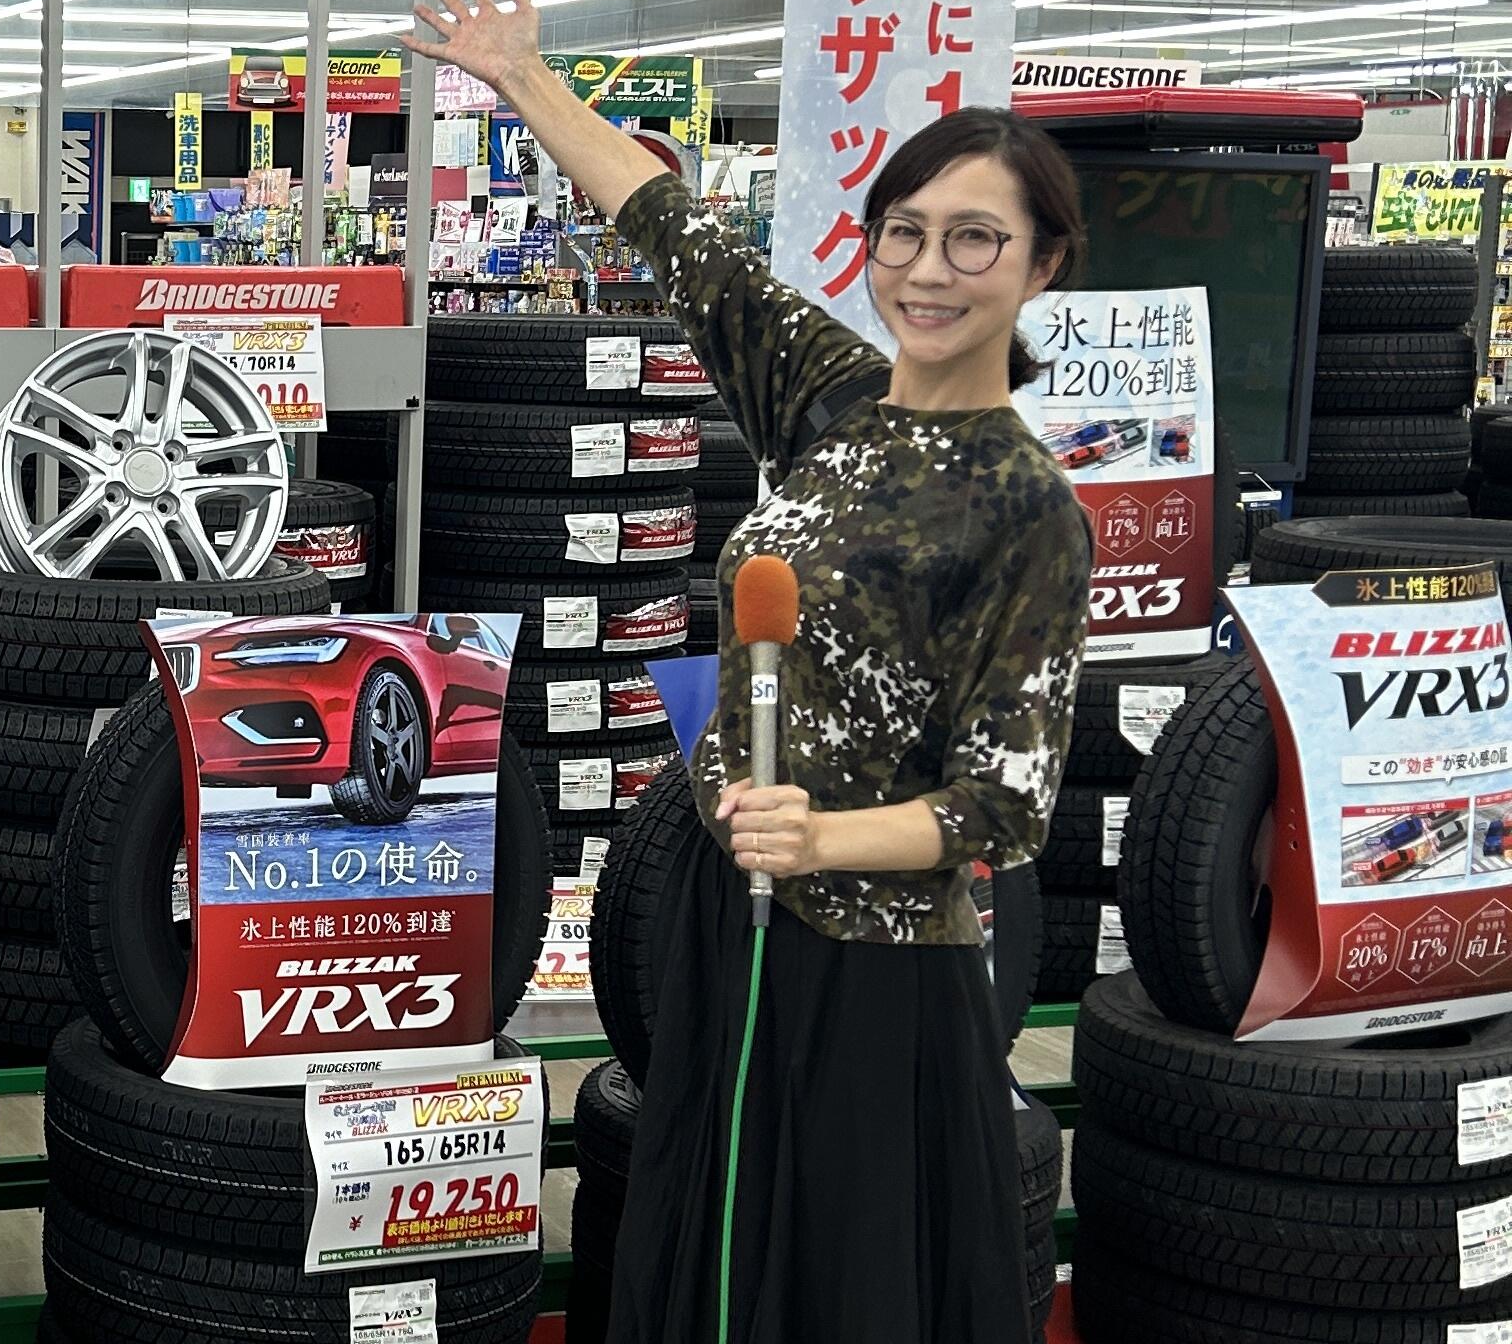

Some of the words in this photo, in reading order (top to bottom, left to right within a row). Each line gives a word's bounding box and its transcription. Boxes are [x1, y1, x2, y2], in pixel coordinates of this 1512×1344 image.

[328, 59, 381, 75] elcome
[1011, 60, 1187, 89] BRIDGESTONE
[178, 114, 199, 185] 洗車用品
[135, 279, 340, 311] BRIDGESTONE
[1043, 304, 1194, 352] 氷上性能
[233, 332, 308, 352] VRX3
[223, 355, 296, 372] 5/70R14
[1041, 355, 1197, 397] 120%到達
[1105, 517, 1139, 538] 17%
[1155, 516, 1189, 539] 向上
[1331, 621, 1506, 659] BLIZZAK
[1331, 652, 1510, 732] VRX3
[236, 832, 310, 848] 雪国装着率
[224, 840, 478, 893] No.1の使命。
[240, 909, 452, 942] 氷上性能120%到達
[1346, 944, 1388, 969] 20%
[1408, 937, 1448, 961] 17%
[1465, 932, 1508, 960] 向上
[276, 954, 420, 978] BLIZZAK
[233, 973, 462, 1048] VRX3
[1368, 1009, 1448, 1029] BRIDGESTONE
[307, 1061, 382, 1074] BRIDGESTONE
[460, 1071, 522, 1088] PREMIUM
[413, 1088, 523, 1128] VRX3
[352, 1123, 389, 1137] BLIZZAK
[384, 1129, 506, 1167] 165/65R14
[335, 1181, 371, 1197] 1本価格
[384, 1306, 423, 1321] VRX3
